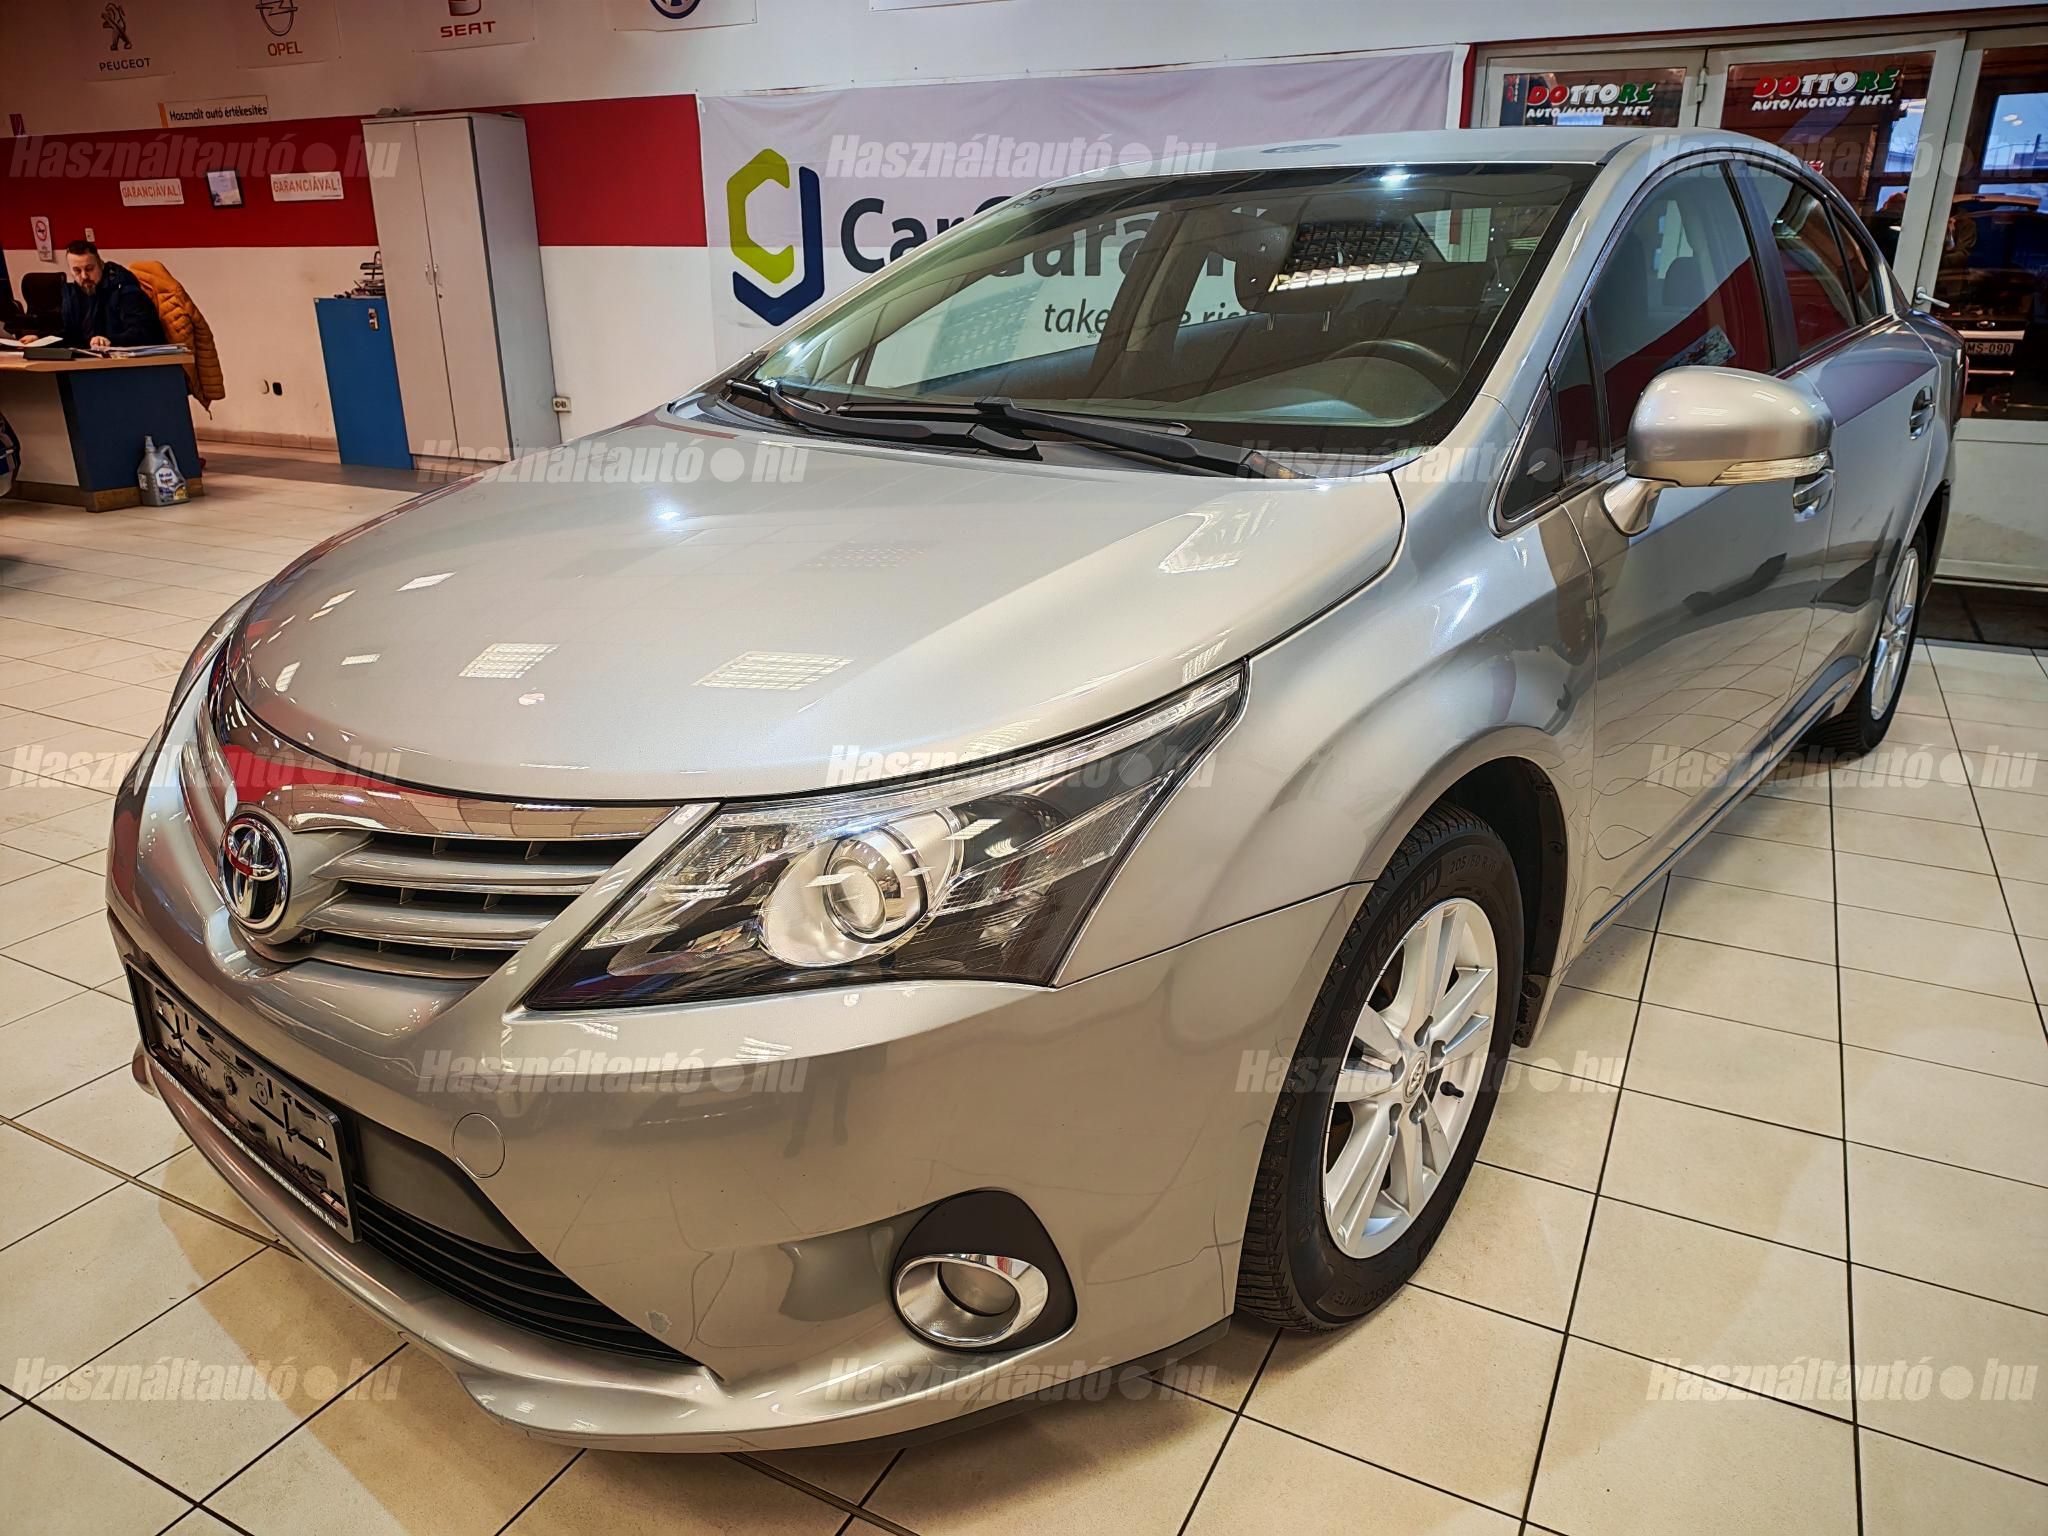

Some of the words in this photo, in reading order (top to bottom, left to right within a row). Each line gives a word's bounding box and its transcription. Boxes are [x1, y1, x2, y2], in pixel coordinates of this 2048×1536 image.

[440, 21, 496, 38] SEAT
[268, 41, 303, 56] OPEL
[99, 57, 151, 71] PEUGEOT
[1753, 67, 1900, 98] DOTTORE
[1526, 82, 1656, 105] DOTTORE
[1752, 95, 1857, 111] AUTO/MOTORS
[1859, 93, 1894, 106] KFT.
[169, 108, 204, 120] Használt
[206, 108, 223, 119] autó
[1621, 105, 1652, 117] KFT.
[272, 175, 341, 193] GARANCIÁVAL!
[1044, 298, 1112, 333] take
